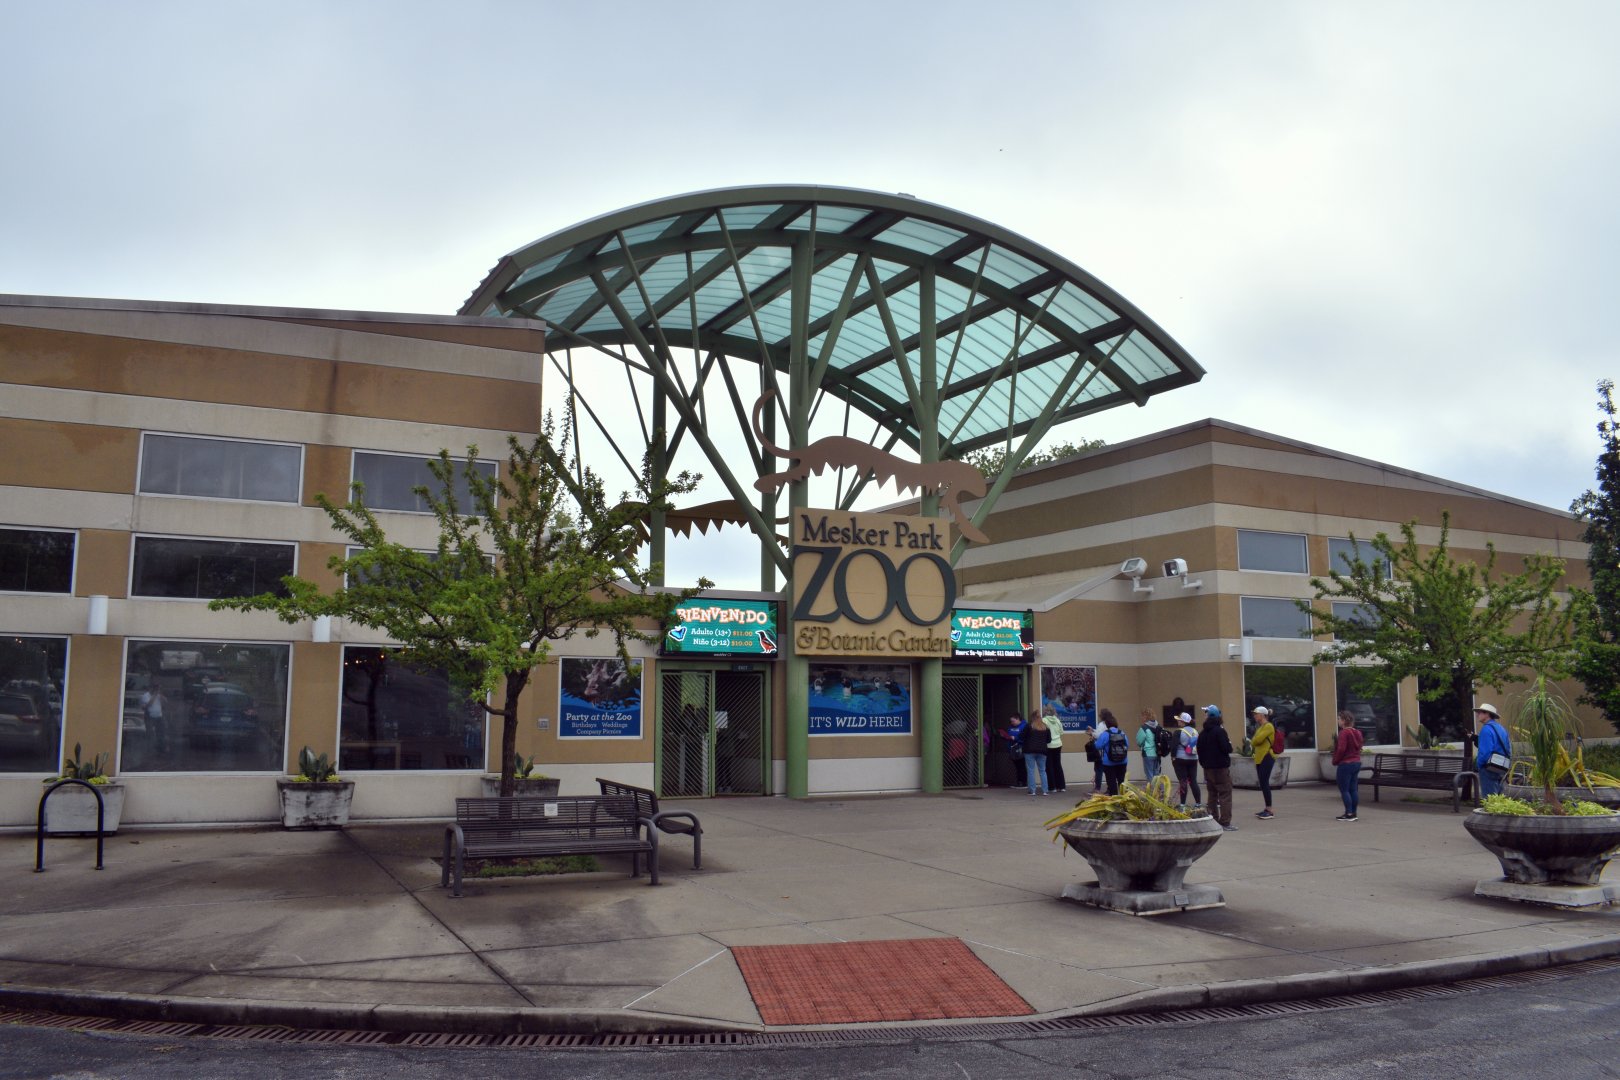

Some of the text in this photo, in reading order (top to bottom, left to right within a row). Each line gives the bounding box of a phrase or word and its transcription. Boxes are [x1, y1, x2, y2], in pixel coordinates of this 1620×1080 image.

[801, 514, 943, 550] Mesker Park
[791, 545, 957, 627] ZOO
[676, 606, 768, 624] BIENVENIDO
[958, 616, 1021, 630] WELCOME
[714, 628, 731, 637] (13+)
[815, 626, 885, 651] Botanic
[888, 628, 950, 652] Garden
[693, 638, 709, 646] Niño
[710, 638, 731, 646] (3-12)
[566, 712, 589, 722] Party
[601, 712, 615, 720] the
[810, 716, 903, 728] IT'S WILD HERE!
